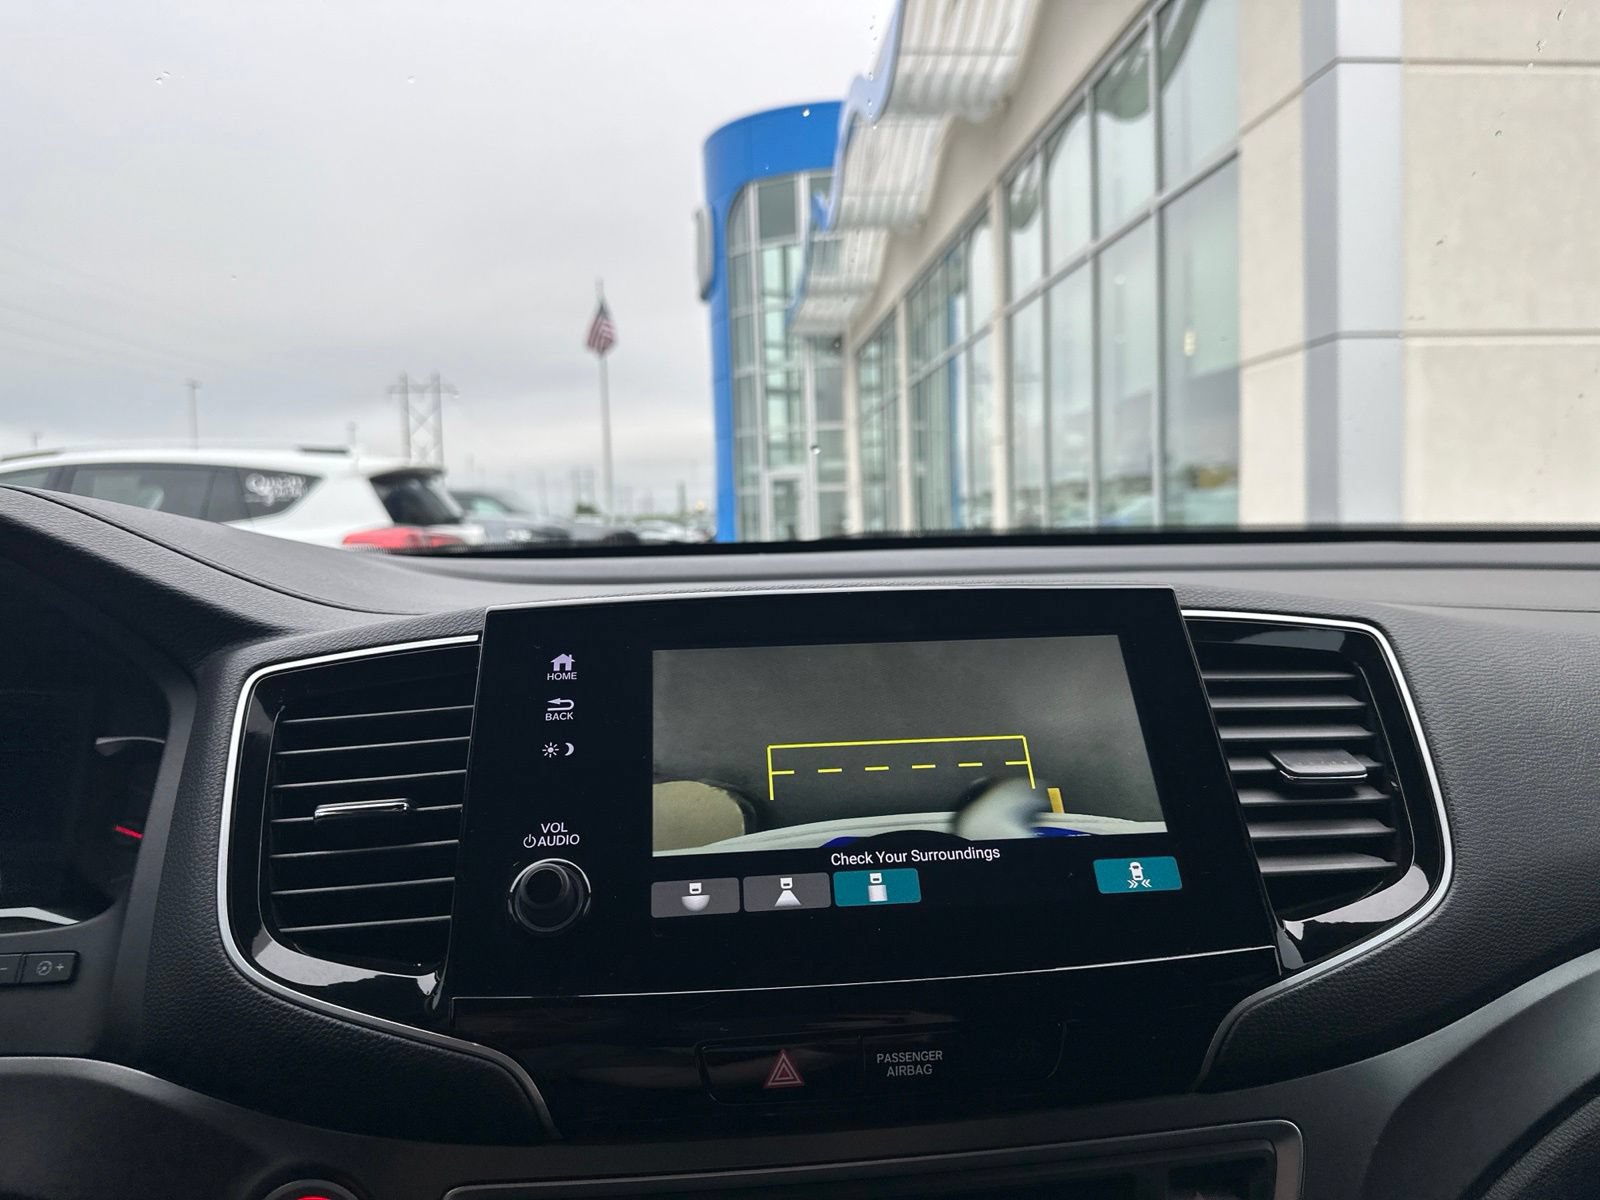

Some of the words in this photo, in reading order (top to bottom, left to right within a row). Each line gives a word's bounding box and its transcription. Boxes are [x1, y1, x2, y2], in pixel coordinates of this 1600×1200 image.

[546, 671, 578, 681] HOME
[545, 711, 574, 722] BACK
[540, 821, 569, 834] VOL
[537, 833, 580, 847] AUDIO
[830, 850, 874, 866] Check
[875, 850, 908, 864] Your
[911, 846, 1001, 862] Surroundings
[876, 1050, 943, 1064] PASSENGER
[886, 1063, 933, 1077] AIRBAG
